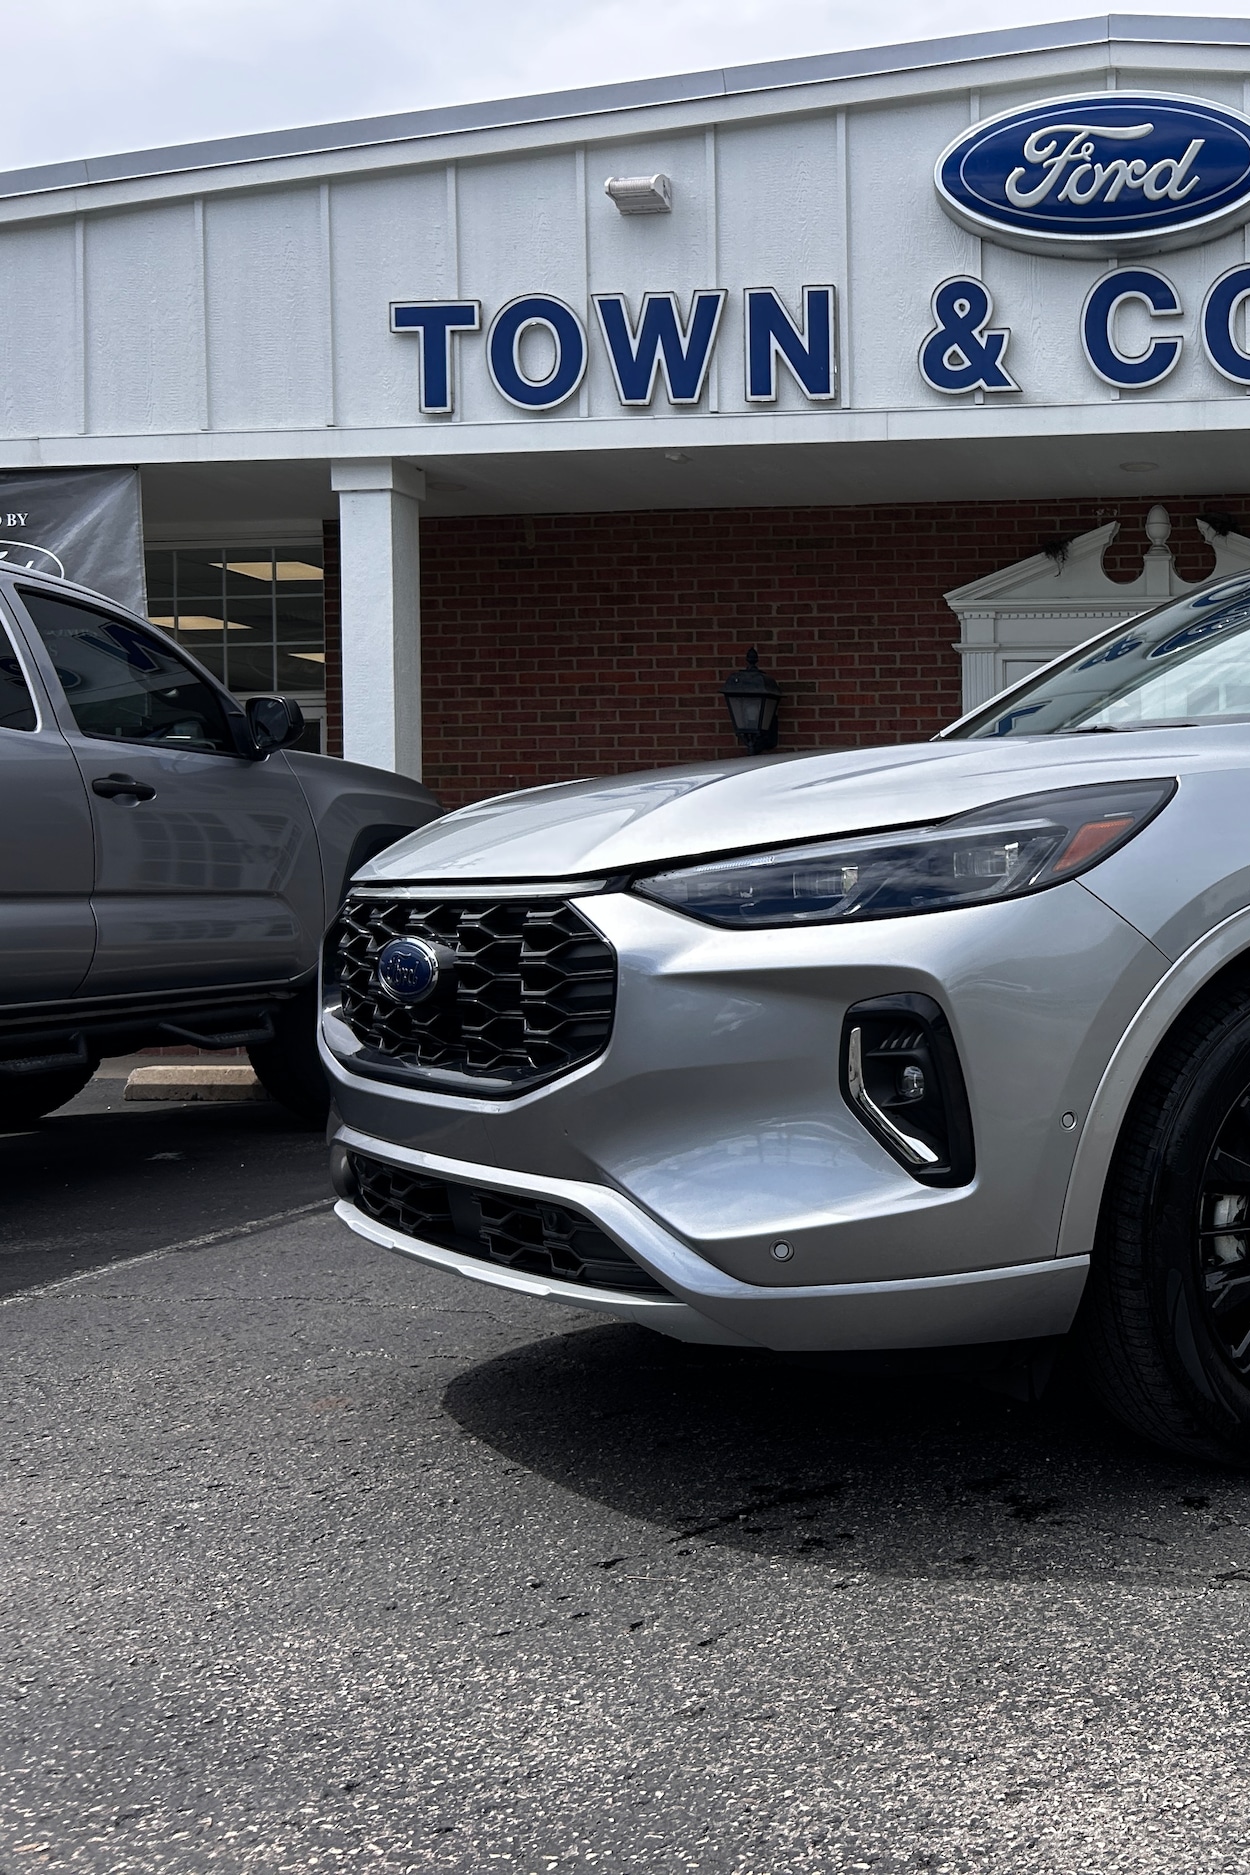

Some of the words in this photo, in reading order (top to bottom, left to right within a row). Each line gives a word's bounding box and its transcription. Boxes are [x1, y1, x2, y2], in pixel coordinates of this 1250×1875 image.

[1005, 123, 1205, 208] Ford
[389, 284, 837, 415] TOWN
[918, 275, 1023, 396] &
[6, 513, 28, 527] BY
